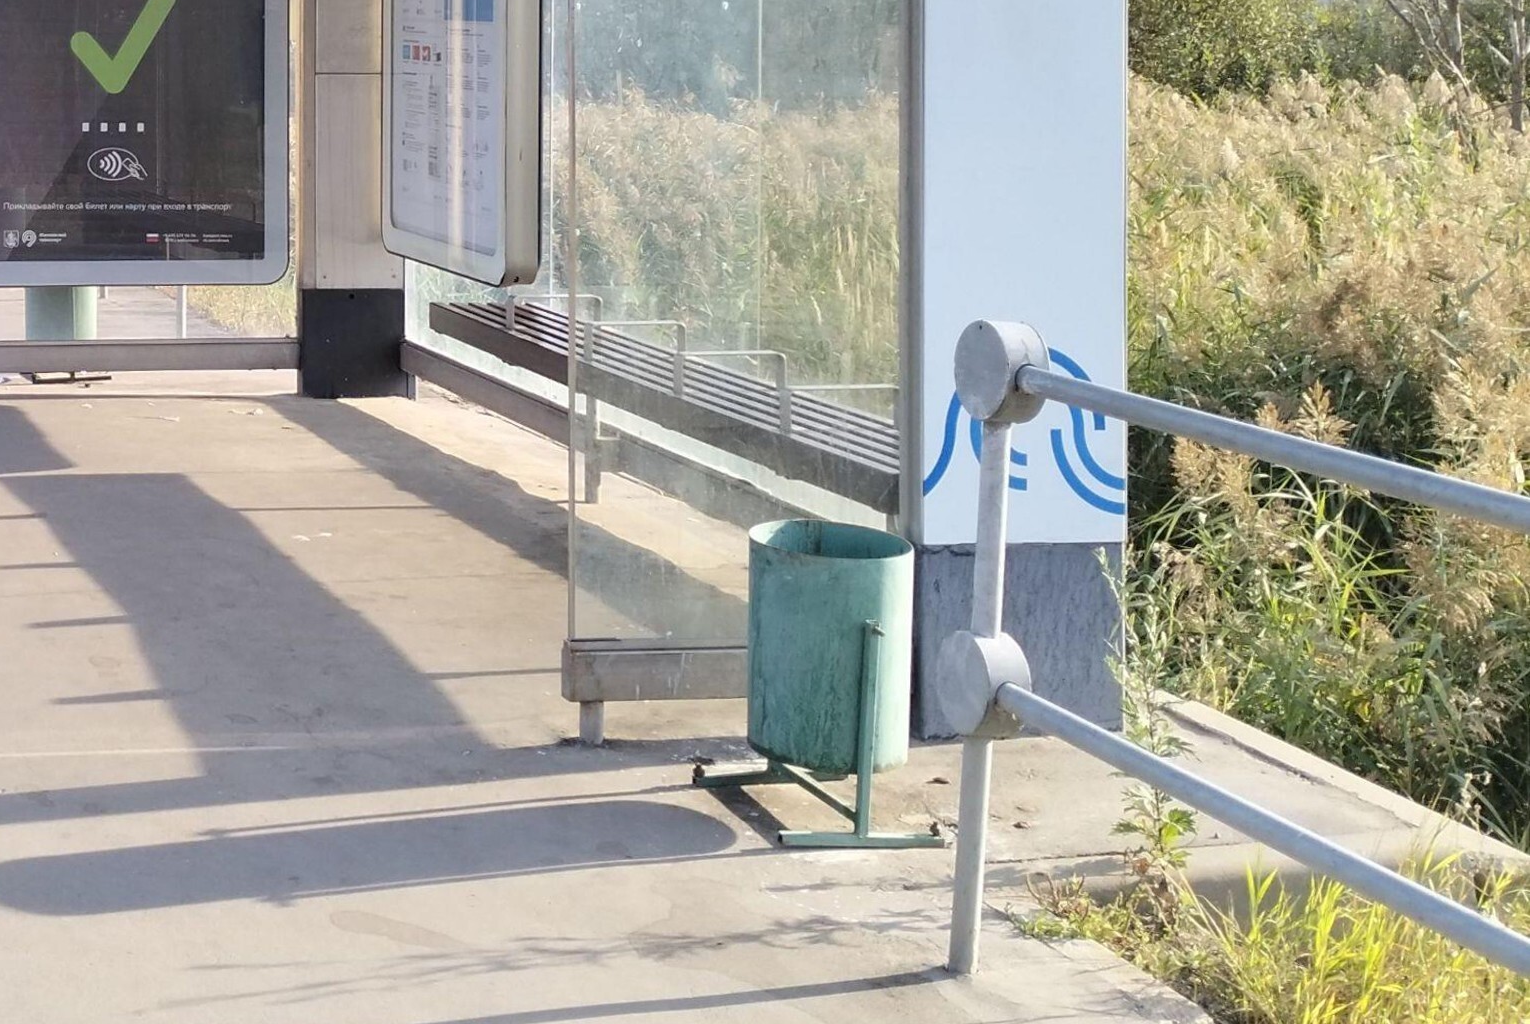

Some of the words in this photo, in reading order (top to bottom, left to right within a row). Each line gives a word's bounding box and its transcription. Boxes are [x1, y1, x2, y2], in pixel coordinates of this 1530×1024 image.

[65, 201, 84, 211] свой
[85, 202, 108, 211] билет
[109, 203, 124, 211] или
[125, 203, 146, 212] карту
[147, 203, 162, 212] при
